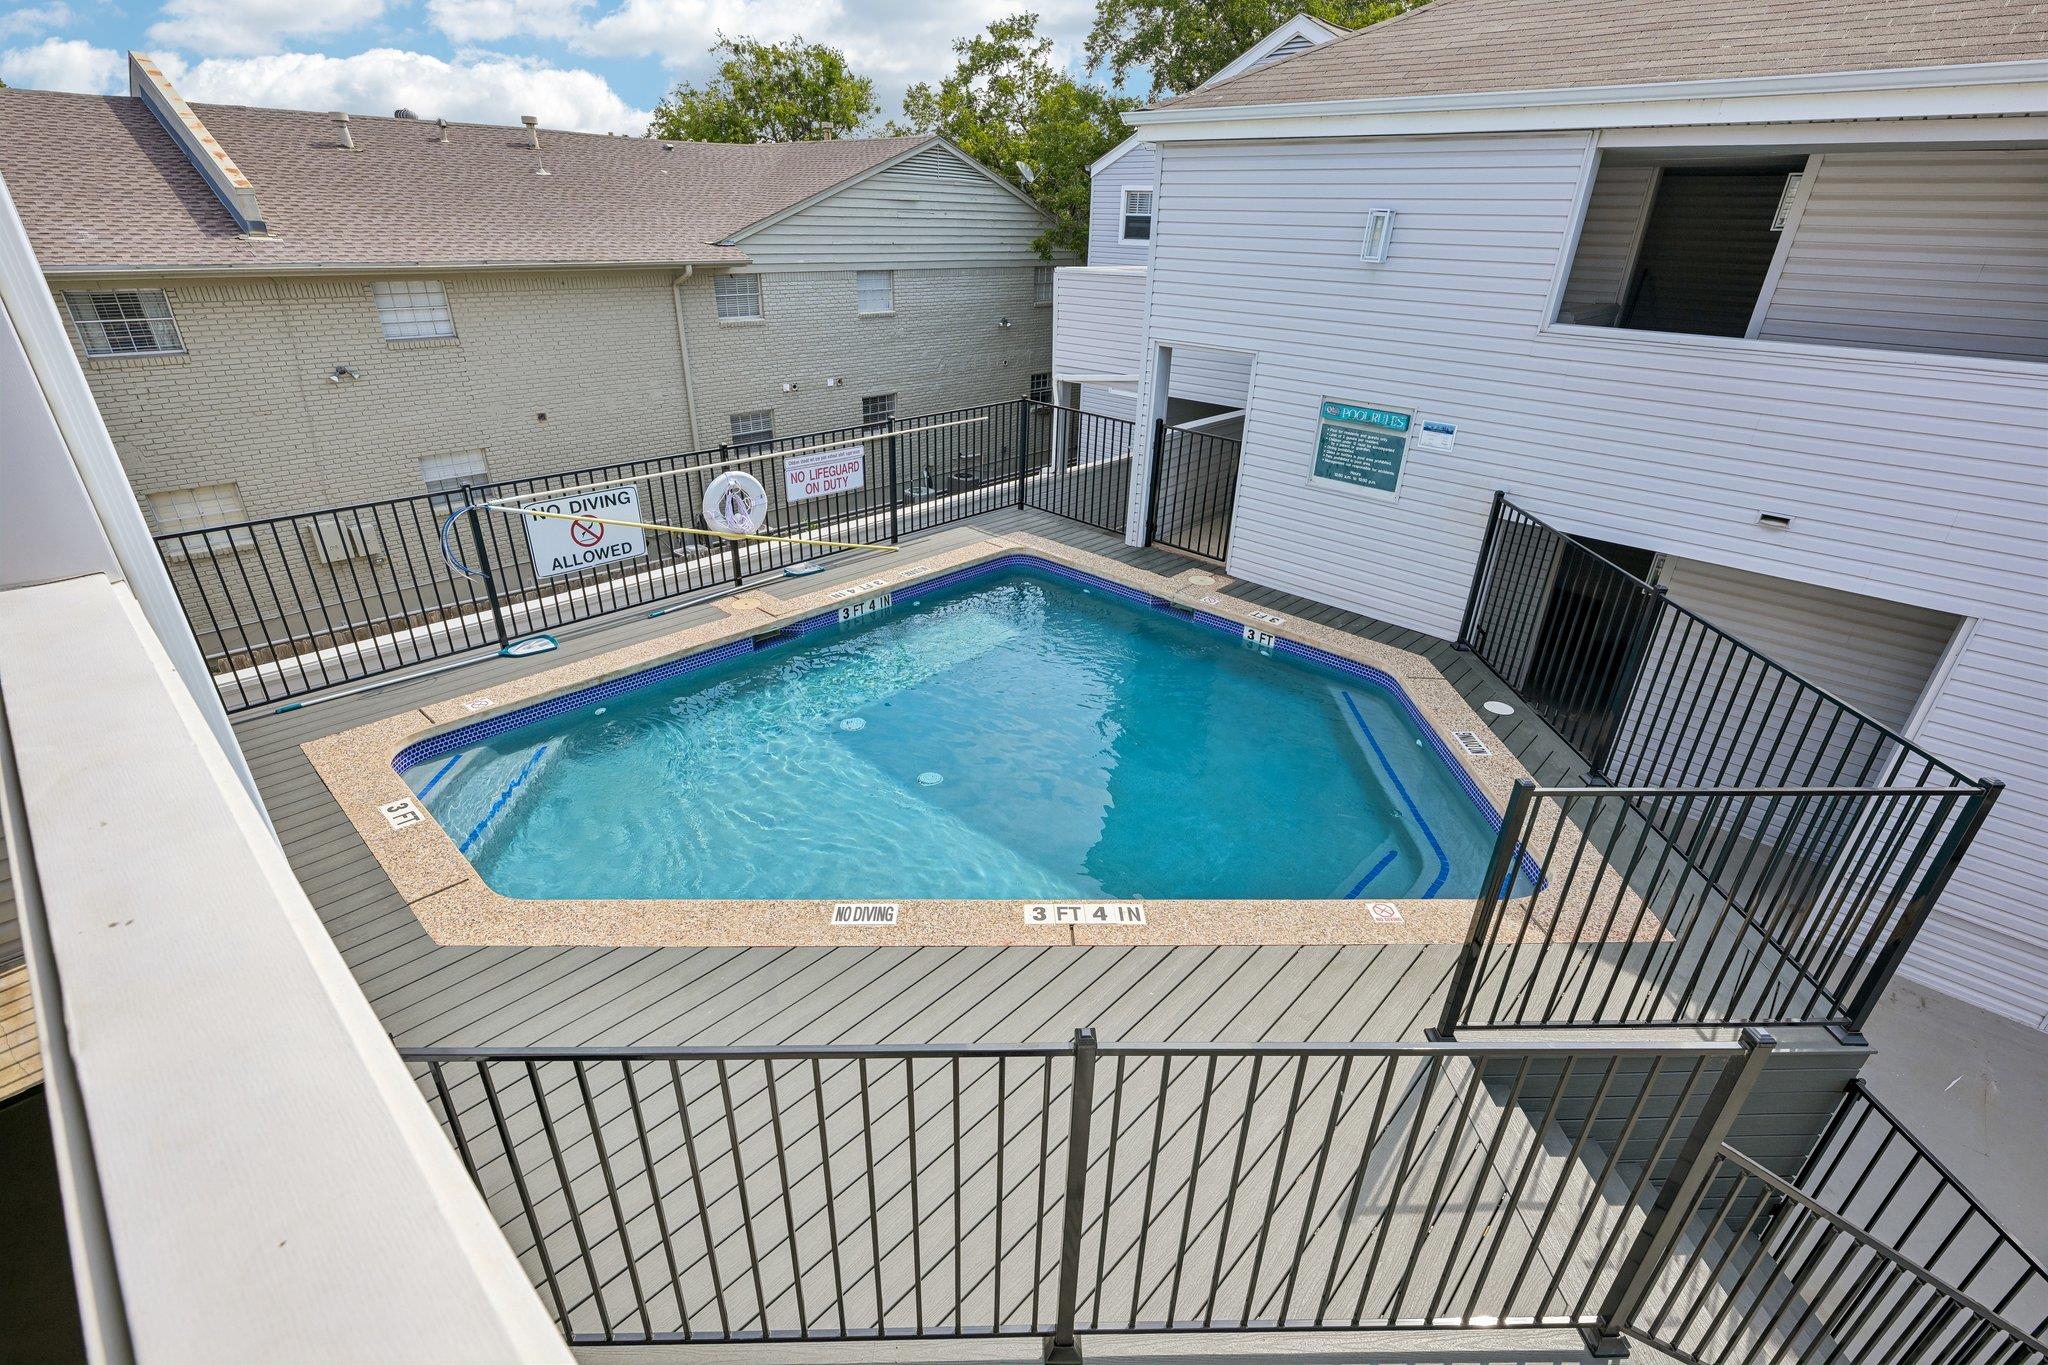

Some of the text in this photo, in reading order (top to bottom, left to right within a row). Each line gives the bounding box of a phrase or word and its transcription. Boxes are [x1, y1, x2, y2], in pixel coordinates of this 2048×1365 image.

[1342, 408, 1370, 422] POOL
[1372, 412, 1404, 428] RULES
[790, 461, 860, 484] NO LIFEGUARD
[806, 476, 848, 494] ON DUTY
[532, 492, 630, 521] NO DIVING
[552, 542, 632, 571] ALLOWED
[843, 594, 890, 619] 3 FT 4 IN
[1247, 629, 1273, 646] 3 FT
[387, 803, 420, 825] 3 FT
[835, 906, 894, 921] NO DIVING
[1032, 906, 1142, 922] 3 FT 4 IN
